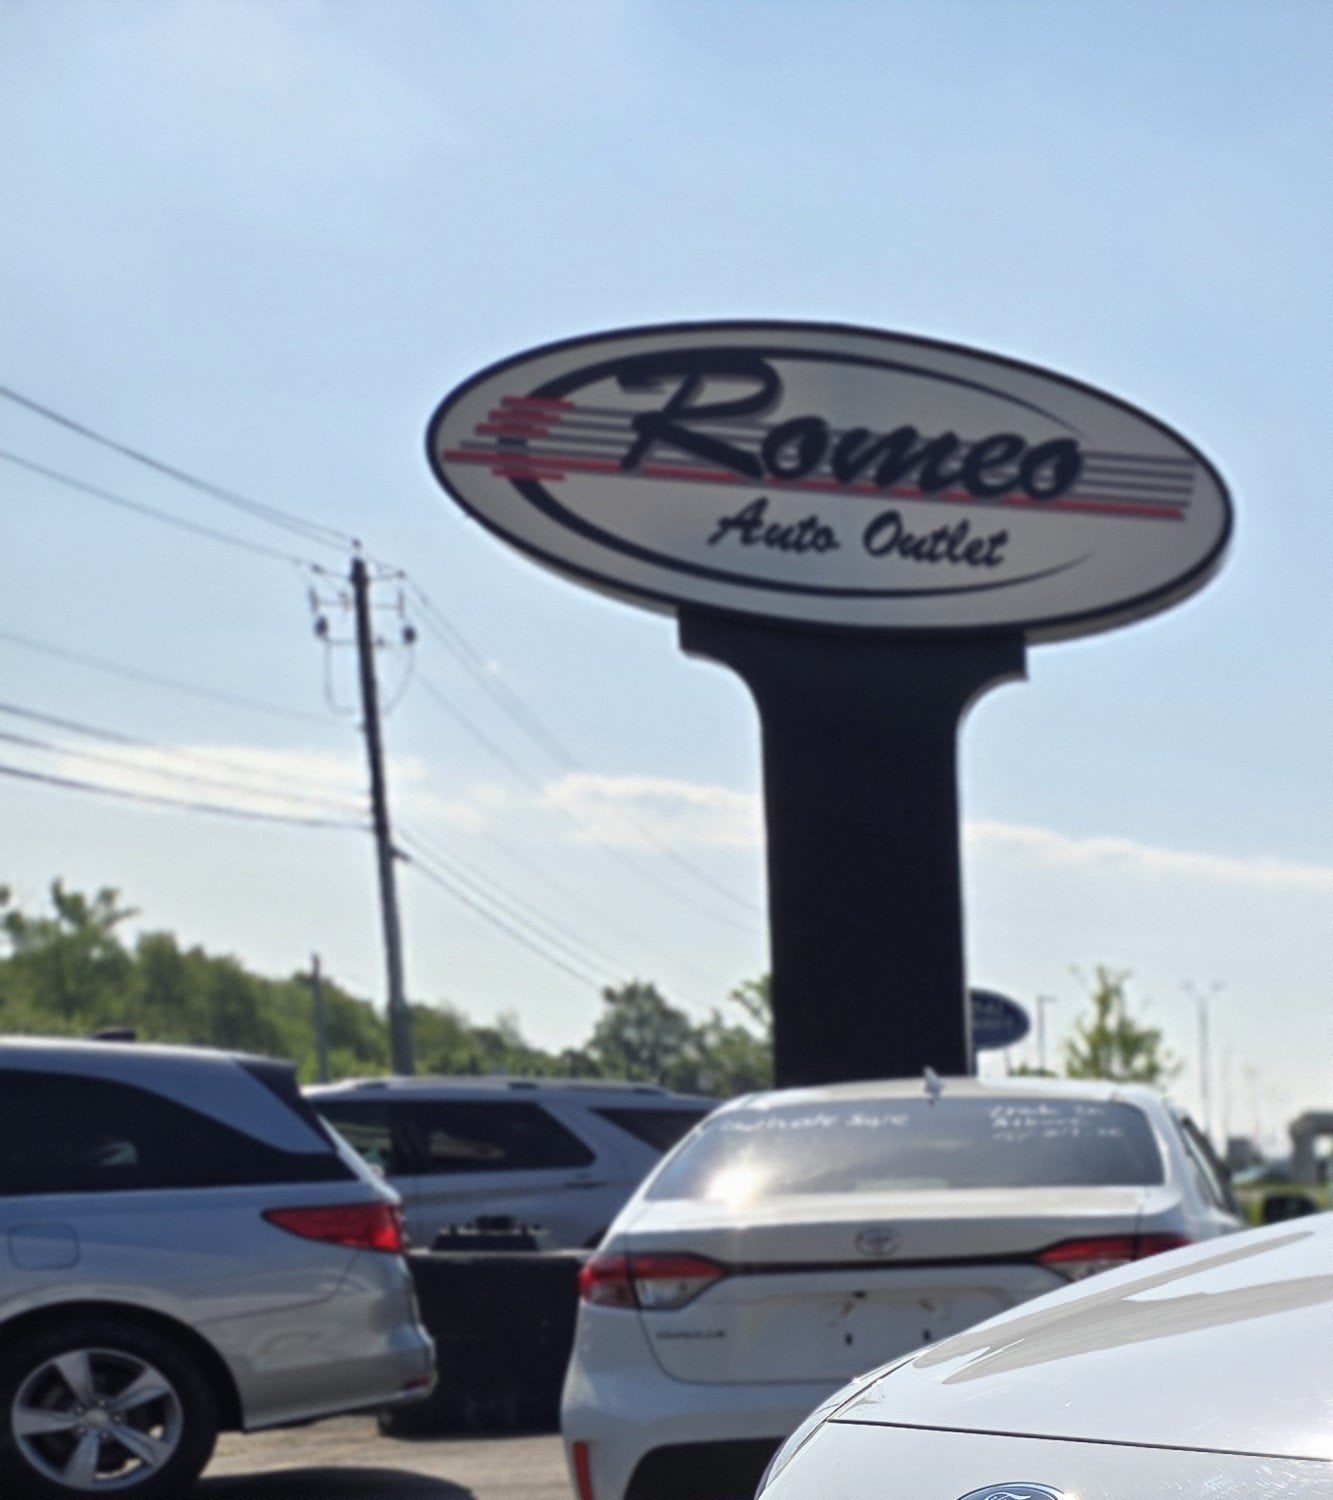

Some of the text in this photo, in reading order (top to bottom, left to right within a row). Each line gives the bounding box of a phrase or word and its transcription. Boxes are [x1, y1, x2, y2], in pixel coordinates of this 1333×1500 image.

[616, 345, 1082, 500] Romeo
[707, 497, 1007, 567] Auto Outlet
